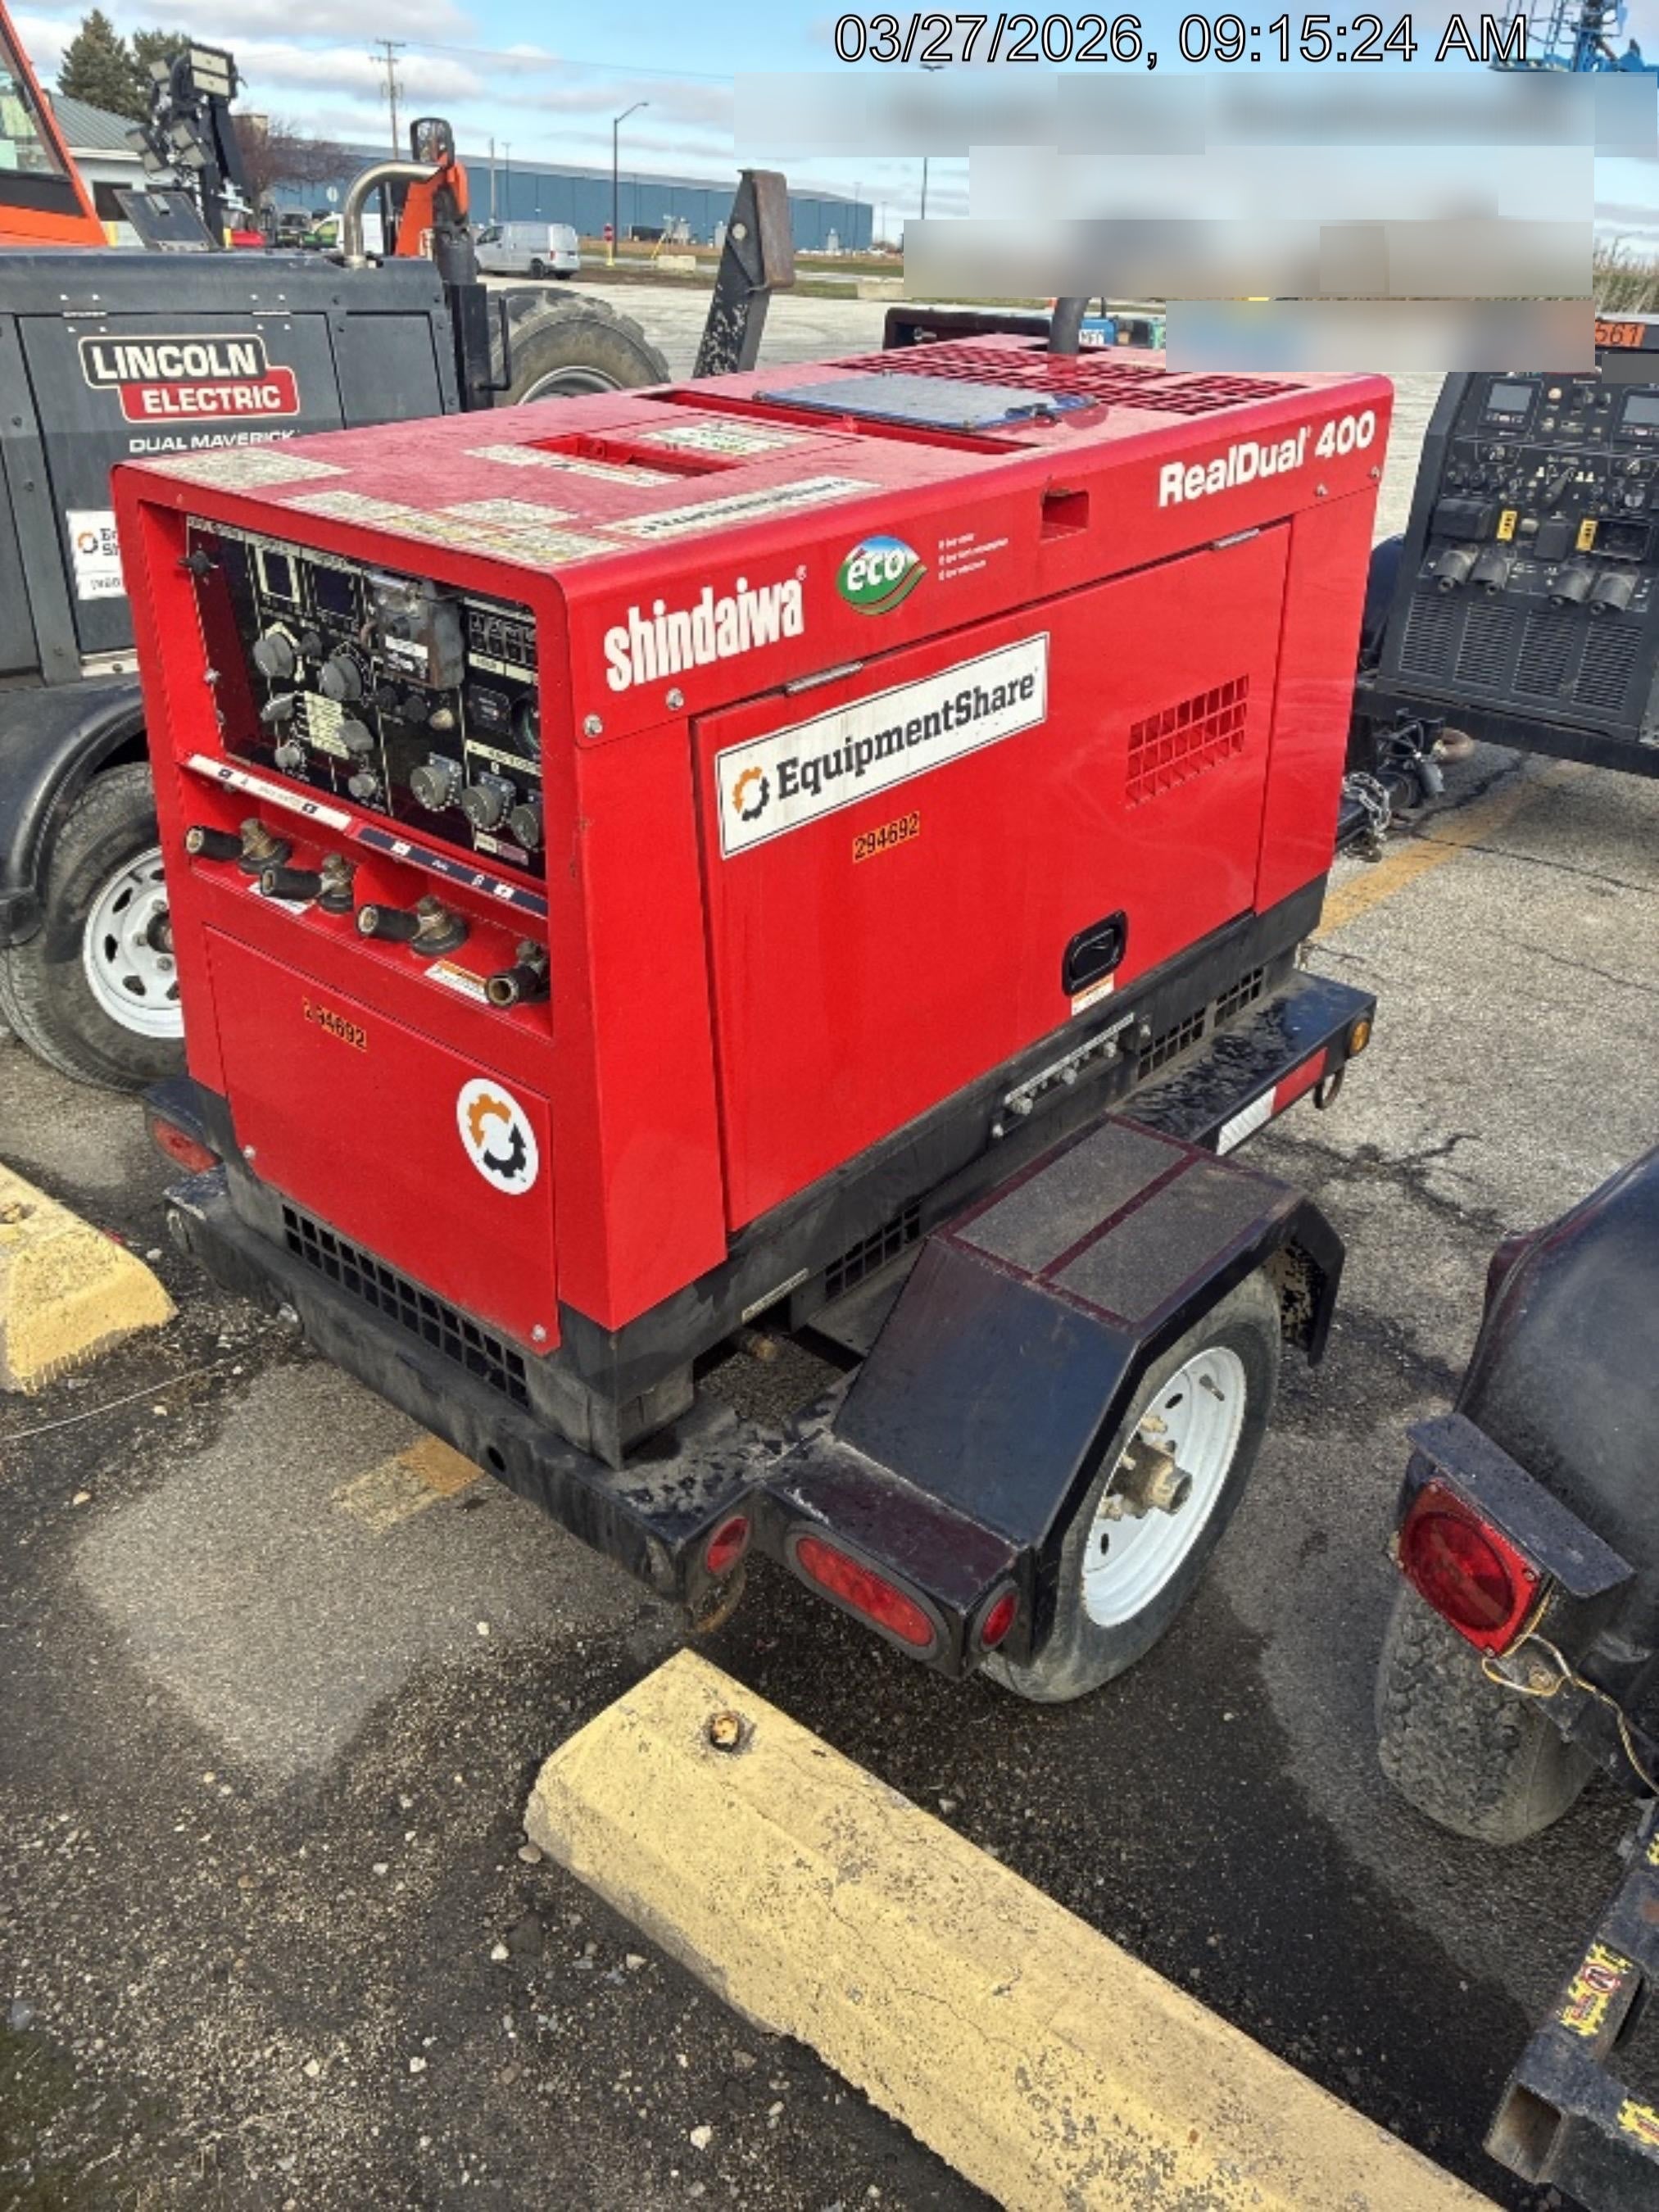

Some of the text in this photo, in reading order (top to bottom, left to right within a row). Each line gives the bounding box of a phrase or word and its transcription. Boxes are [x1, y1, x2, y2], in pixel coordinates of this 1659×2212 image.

[91, 343, 258, 379] LINCOLN
[142, 386, 281, 414] ELECTRIC
[129, 437, 188, 453] DUAL
[1158, 410, 1376, 507] RealDual 400
[604, 575, 805, 692] shindaiwa
[776, 671, 1036, 800] EquipmentShare
[854, 814, 919, 861] 294692
